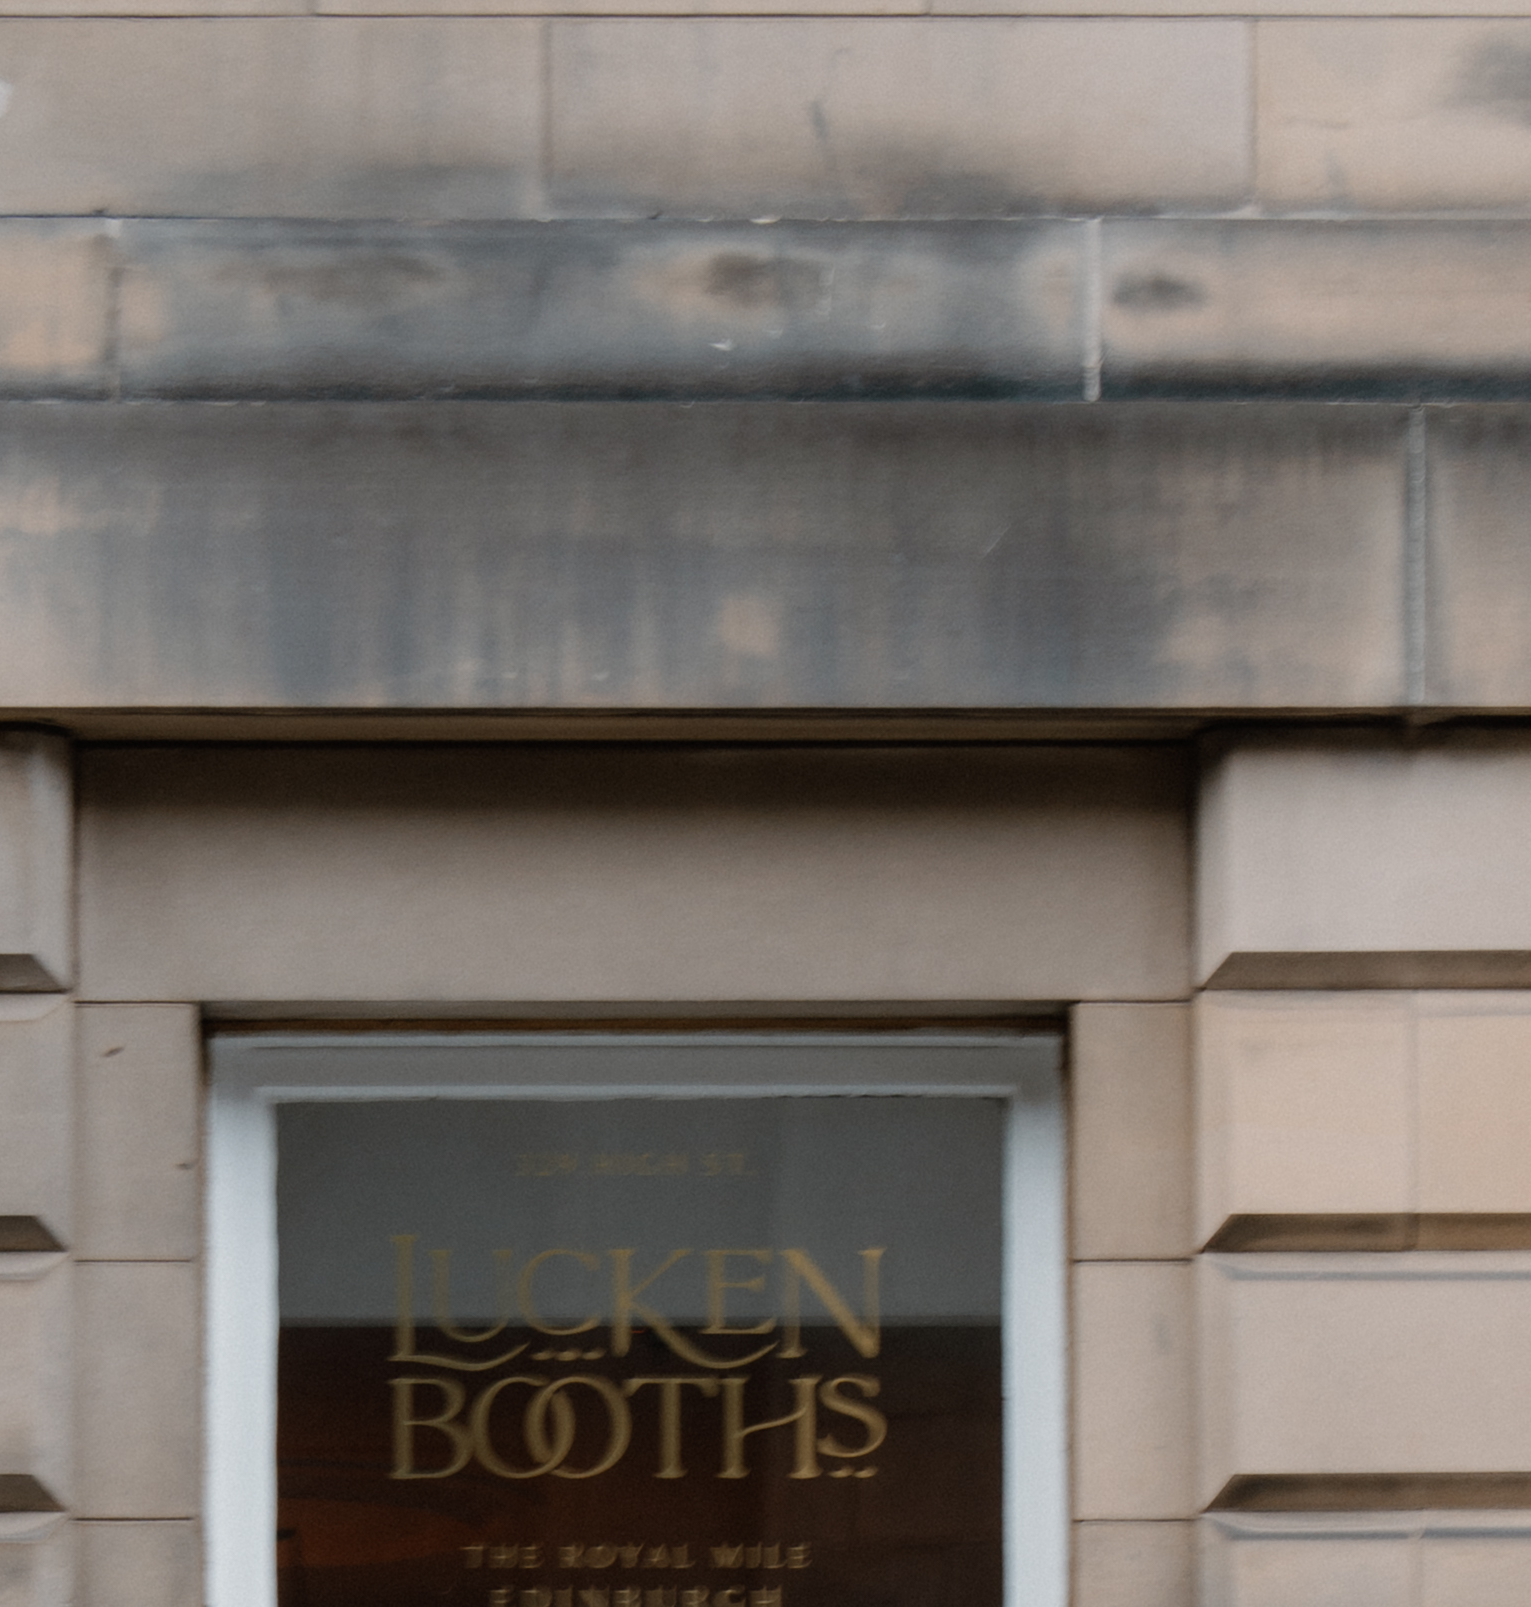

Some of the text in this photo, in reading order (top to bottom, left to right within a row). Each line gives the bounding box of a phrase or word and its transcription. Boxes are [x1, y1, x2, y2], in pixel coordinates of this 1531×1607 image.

[387, 1234, 888, 1371] LUCKEN
[387, 1375, 888, 1481] BOOTHS
[458, 1541, 814, 1570] THE ROYAL MILE
